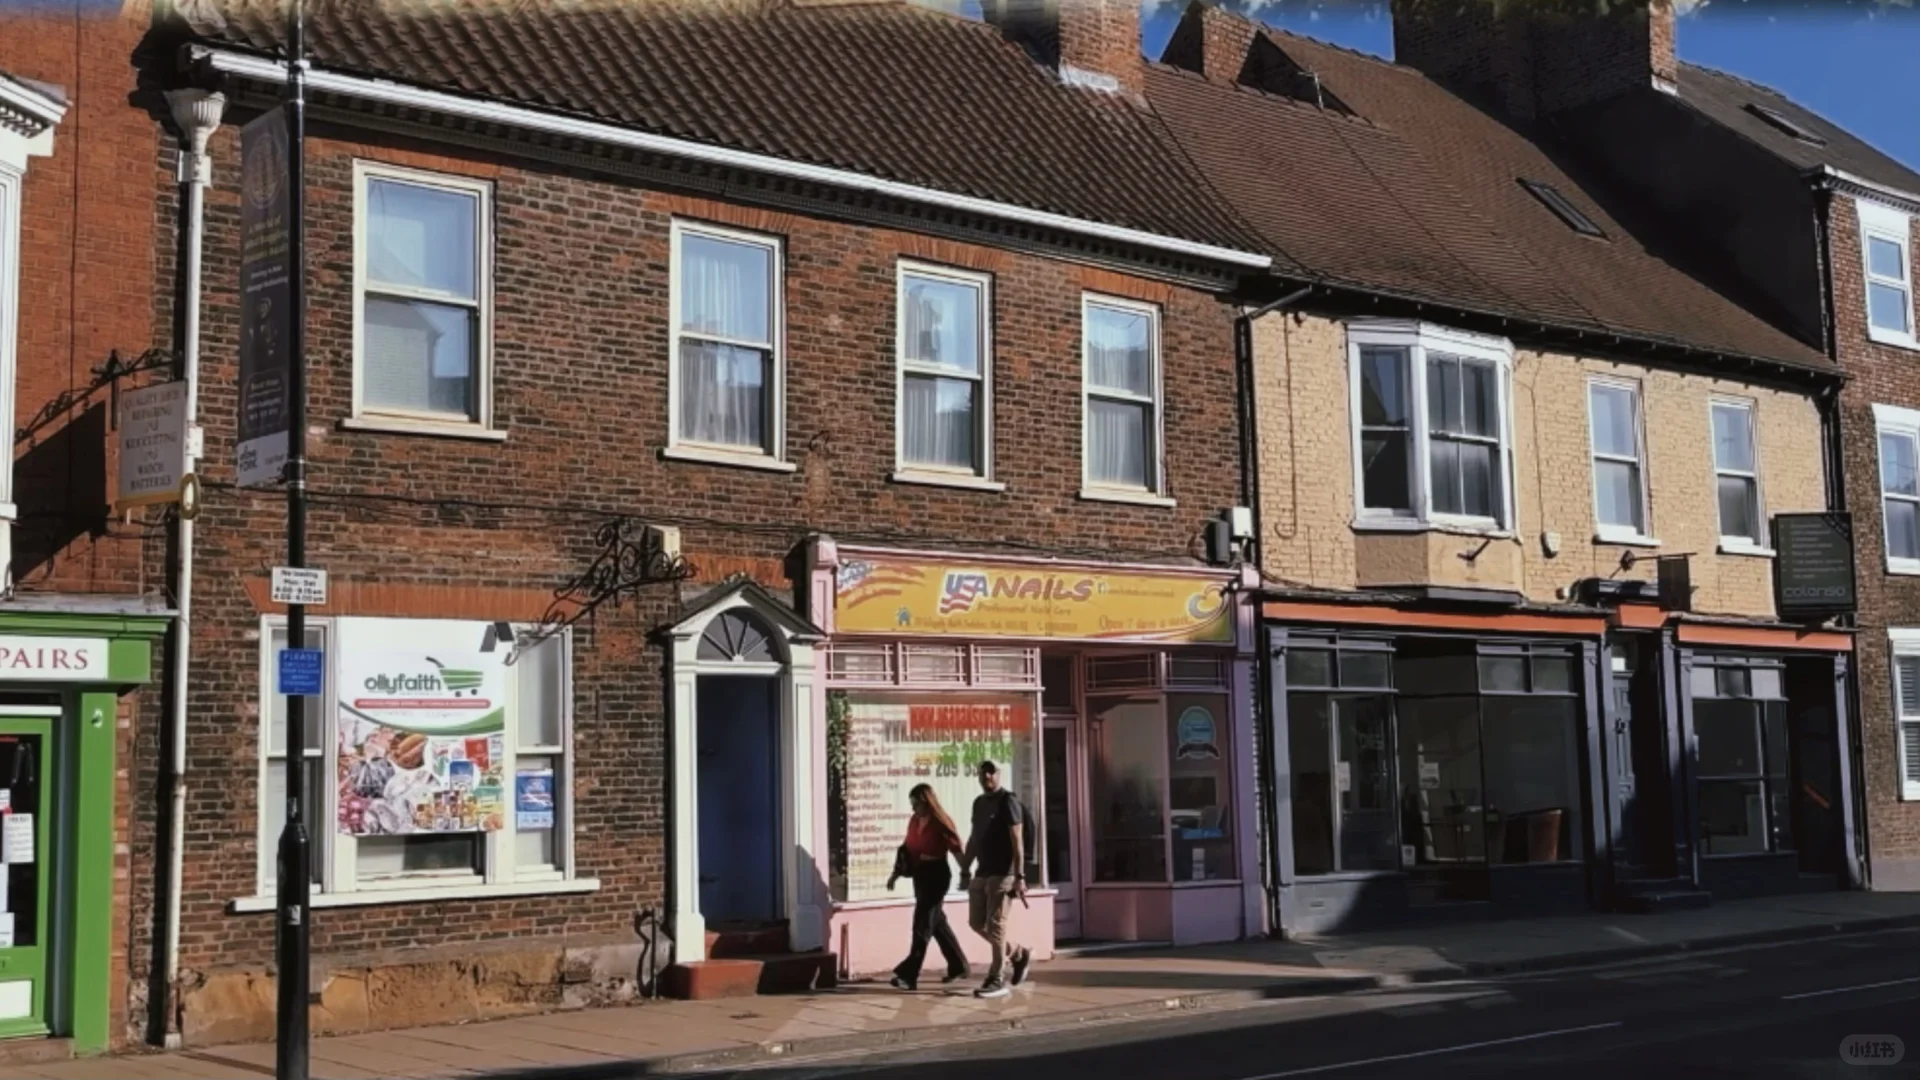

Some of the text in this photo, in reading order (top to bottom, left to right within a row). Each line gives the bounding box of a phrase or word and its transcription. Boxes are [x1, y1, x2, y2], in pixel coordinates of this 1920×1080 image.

[991, 575, 1094, 602] NAILS
[0, 647, 89, 670] PAIRS
[364, 673, 441, 695] ollyfaith
